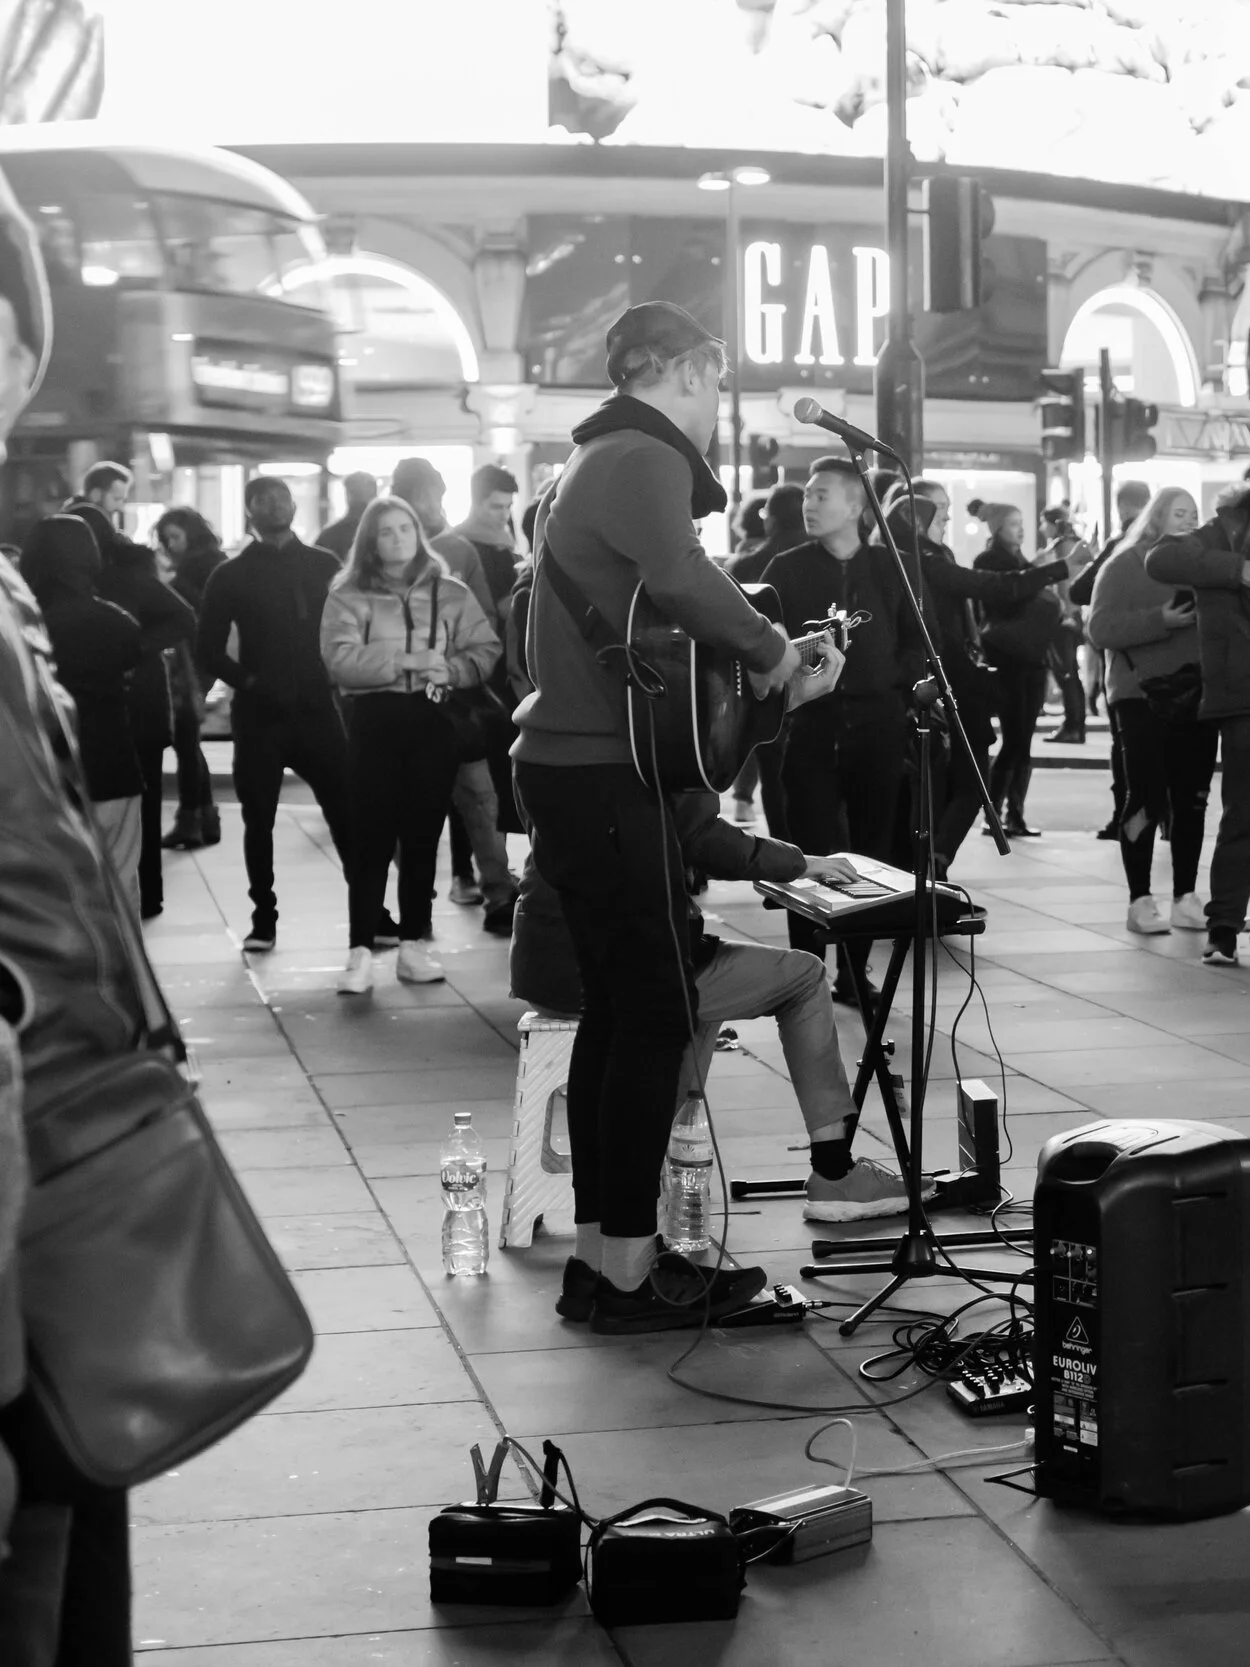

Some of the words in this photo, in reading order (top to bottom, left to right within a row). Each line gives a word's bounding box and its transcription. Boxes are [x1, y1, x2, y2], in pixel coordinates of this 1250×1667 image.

[744, 240, 891, 366] GAP
[441, 1170, 477, 1184] Volvic
[1053, 1355, 1097, 1375] EUROLIV
